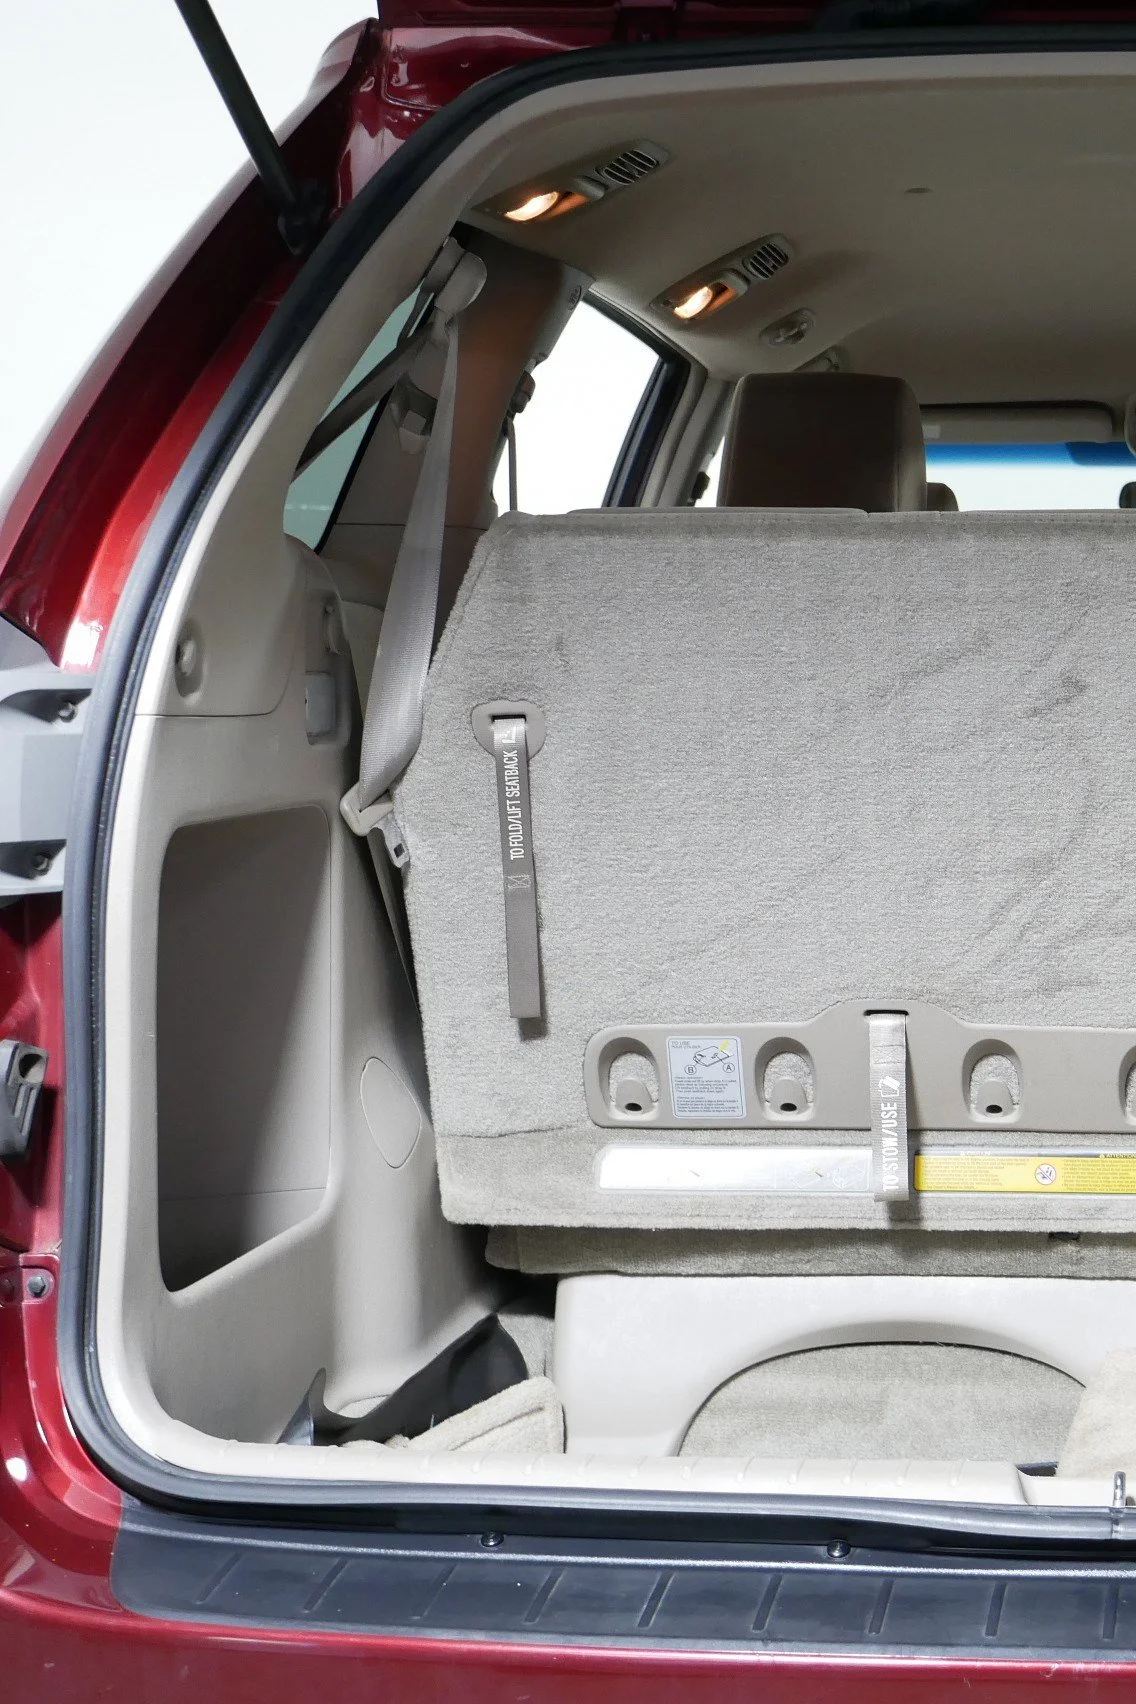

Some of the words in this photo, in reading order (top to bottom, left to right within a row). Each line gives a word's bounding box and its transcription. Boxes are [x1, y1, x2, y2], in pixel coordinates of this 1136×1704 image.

[502, 750, 521, 798] SEATBACK
[506, 799, 524, 847] FOLD/LIFT
[509, 847, 525, 860] TO
[880, 1102, 899, 1171] STOW/USE
[882, 1175, 900, 1192] TO
